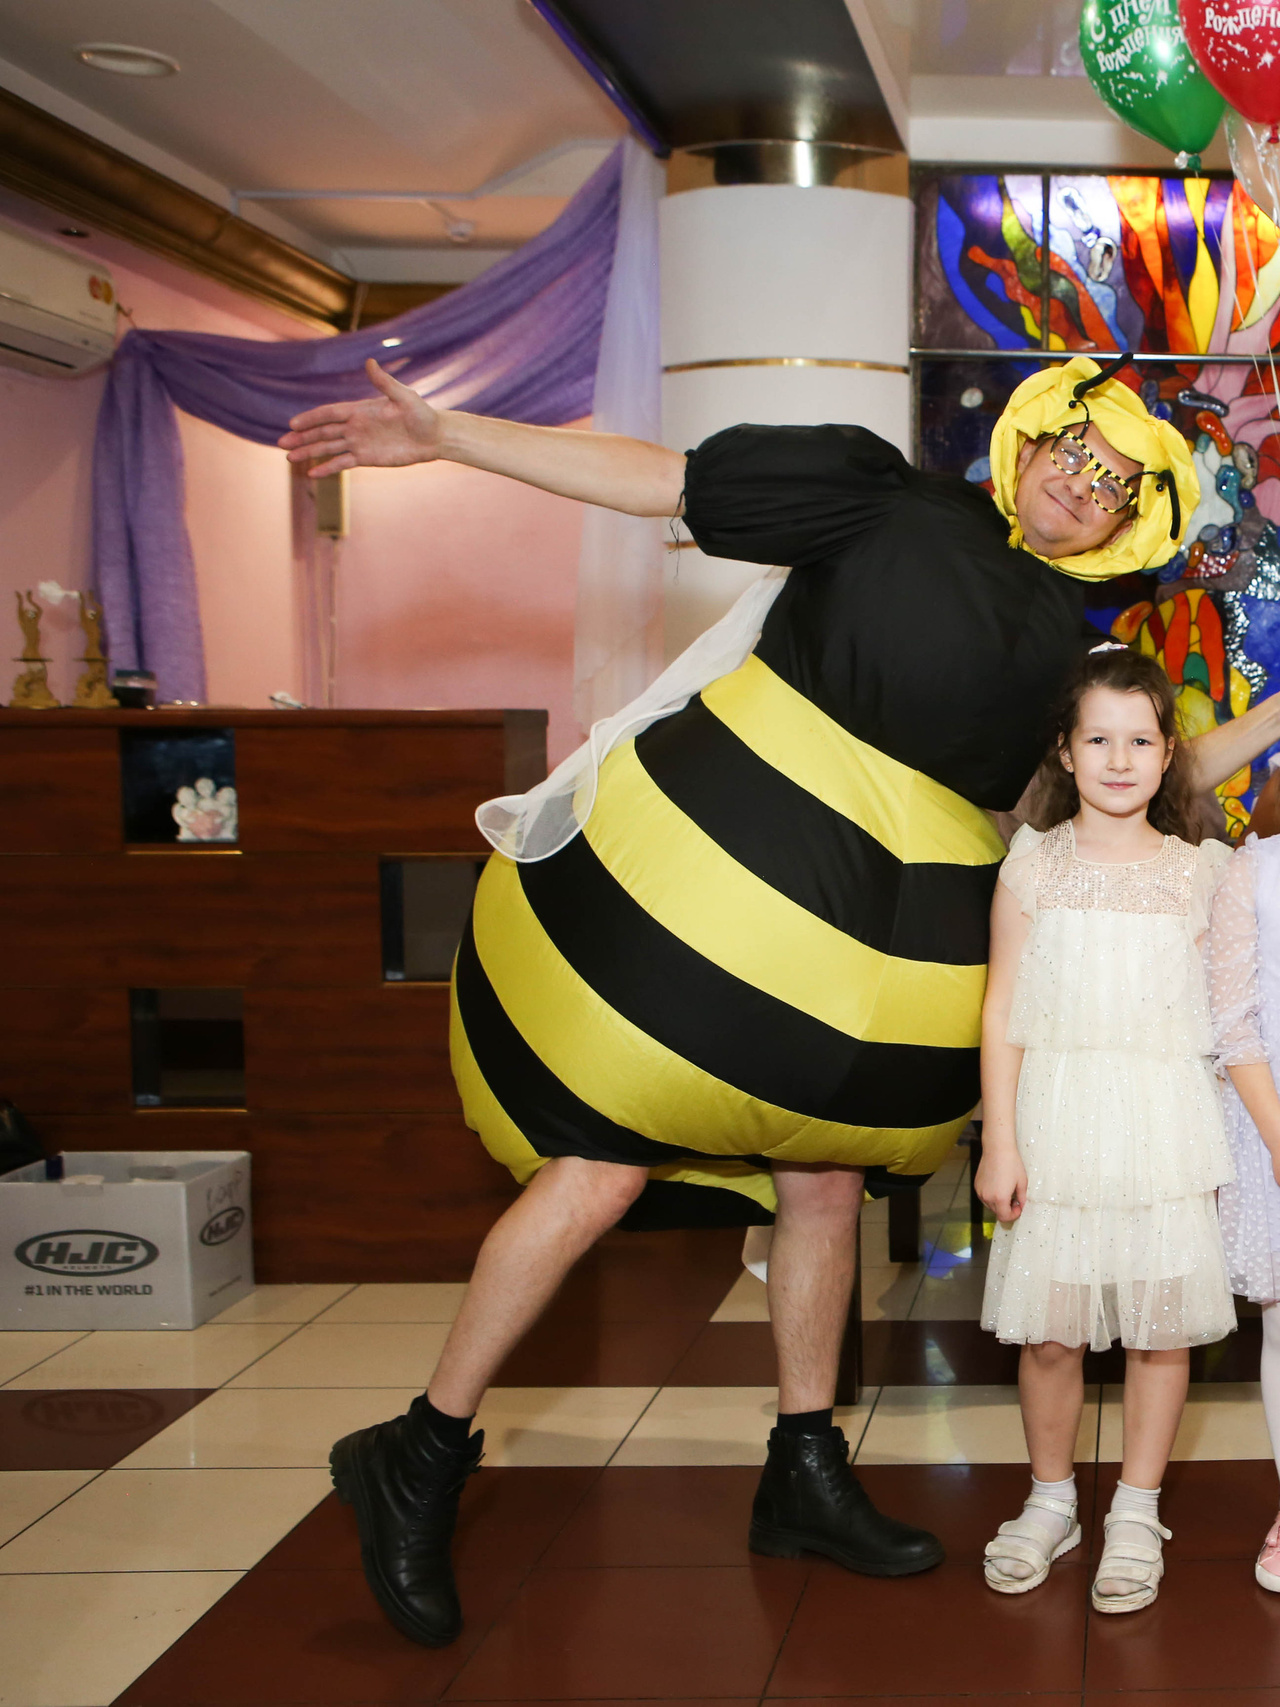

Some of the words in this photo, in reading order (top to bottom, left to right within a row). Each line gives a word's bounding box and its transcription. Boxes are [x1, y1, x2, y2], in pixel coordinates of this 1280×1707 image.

[33, 1242, 140, 1264] HJC
[24, 1285, 44, 1296] #1
[47, 1285, 62, 1295] IN
[64, 1285, 94, 1295] THE
[97, 1284, 153, 1296] WORLD
